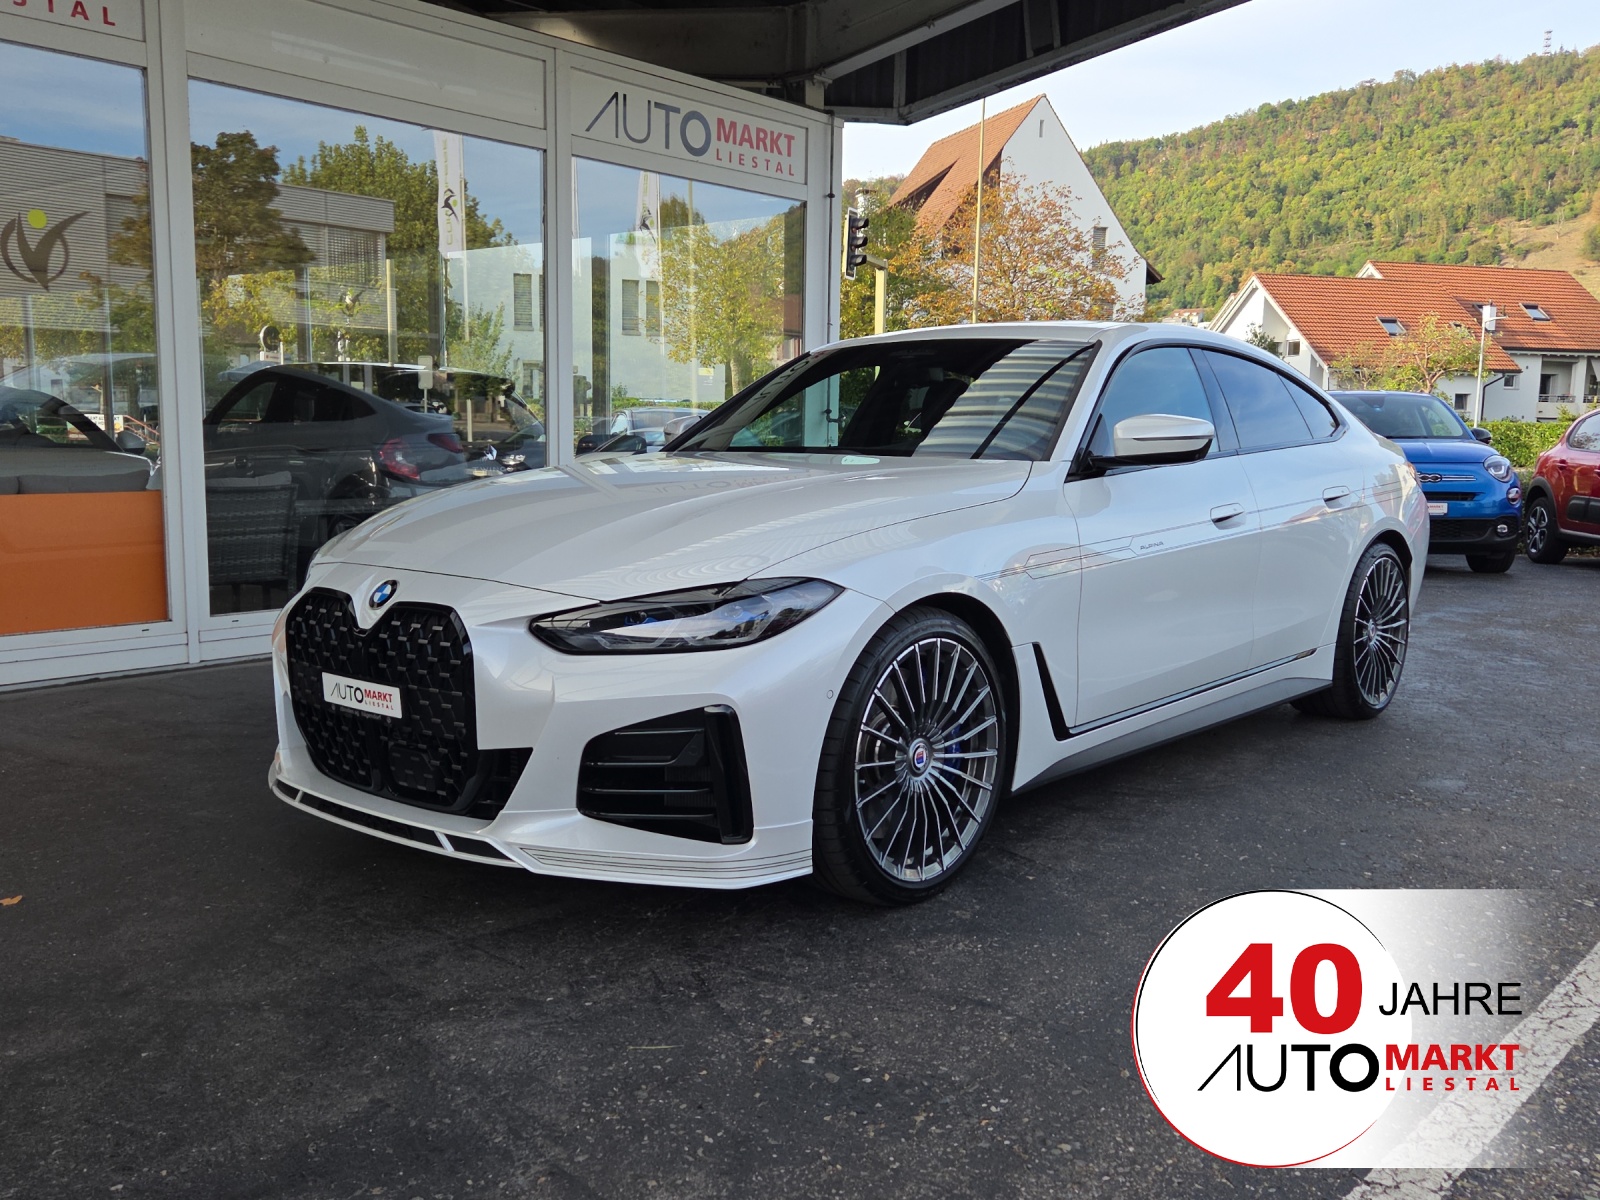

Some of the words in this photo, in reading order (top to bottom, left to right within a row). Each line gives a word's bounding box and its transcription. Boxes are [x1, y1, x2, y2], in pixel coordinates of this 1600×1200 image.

[716, 118, 795, 157] MARKT
[716, 148, 795, 176] LIESTAL
[1140, 541, 1164, 550] ALPINA
[364, 688, 392, 702] MARKT
[365, 701, 393, 710] LIESTAL
